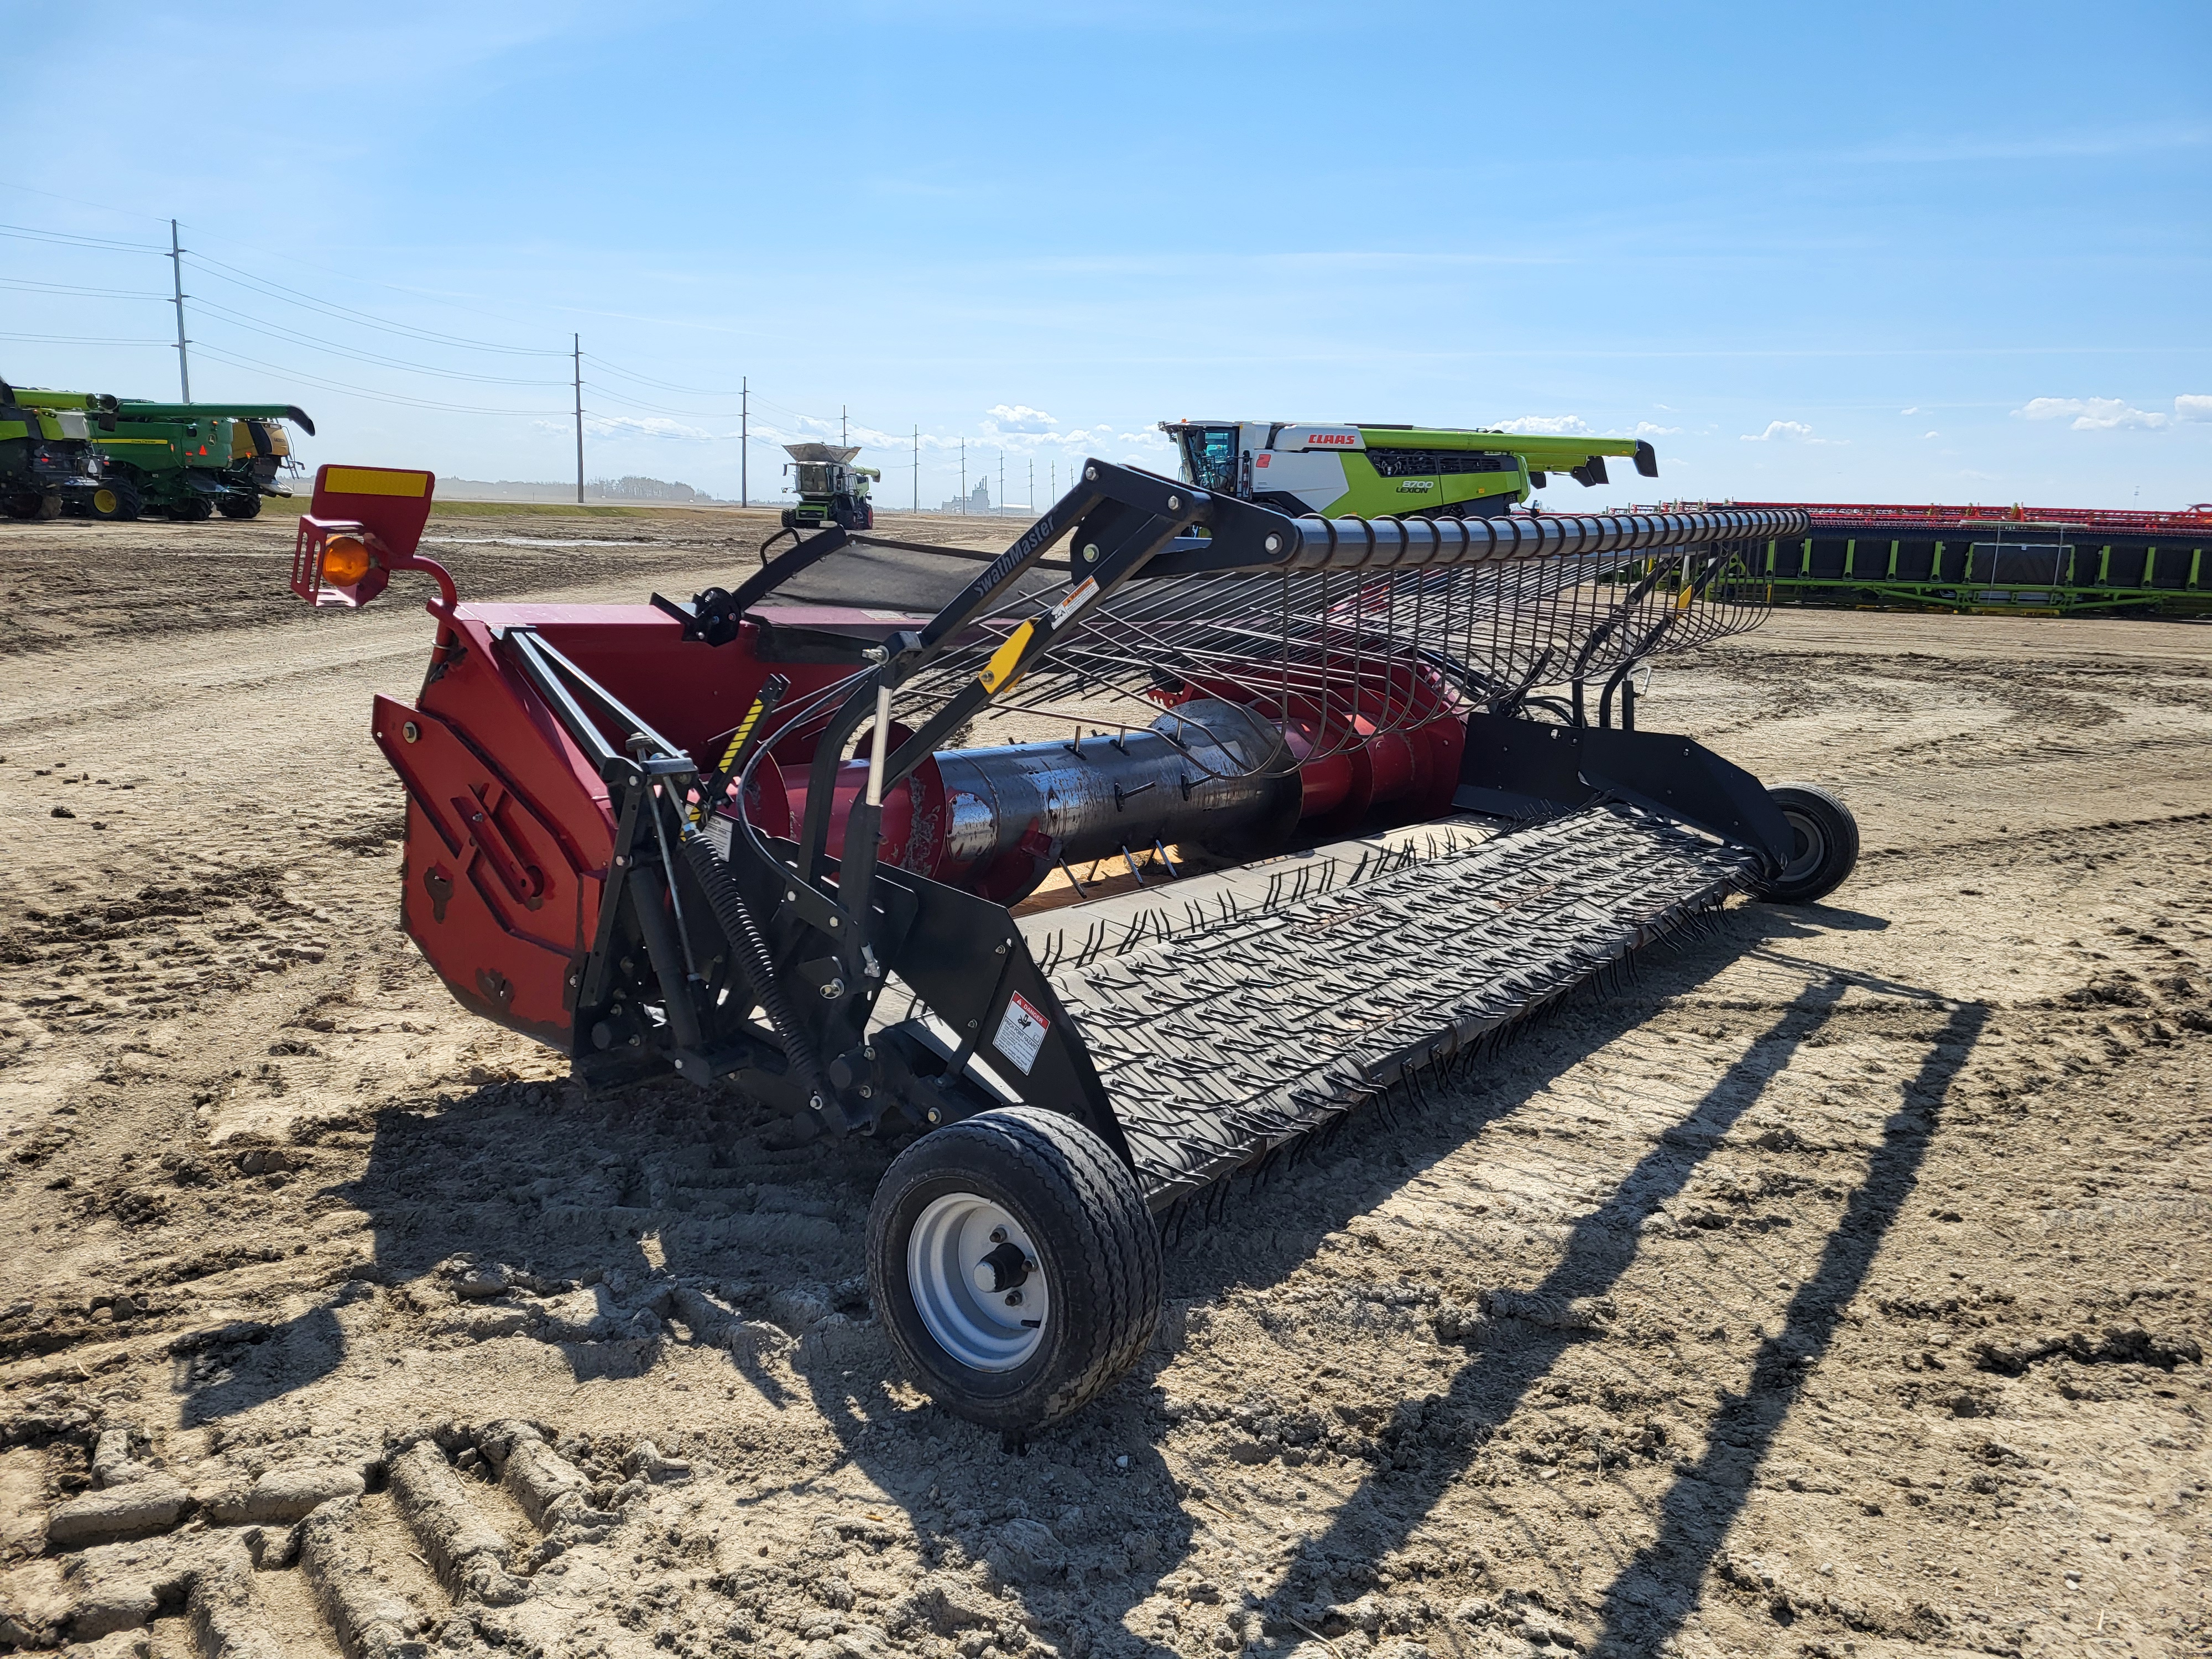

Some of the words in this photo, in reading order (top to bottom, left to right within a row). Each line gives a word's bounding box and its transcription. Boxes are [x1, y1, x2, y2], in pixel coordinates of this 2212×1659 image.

[1308, 434, 1355, 445] CLAAS
[973, 515, 1055, 598] SwathMaster
[1023, 1003, 1044, 1024] DANGER
[1004, 1018, 1015, 1030] PINCH
[1014, 1026, 1024, 1039] POINT
[1023, 1035, 1037, 1050] HAZARD
